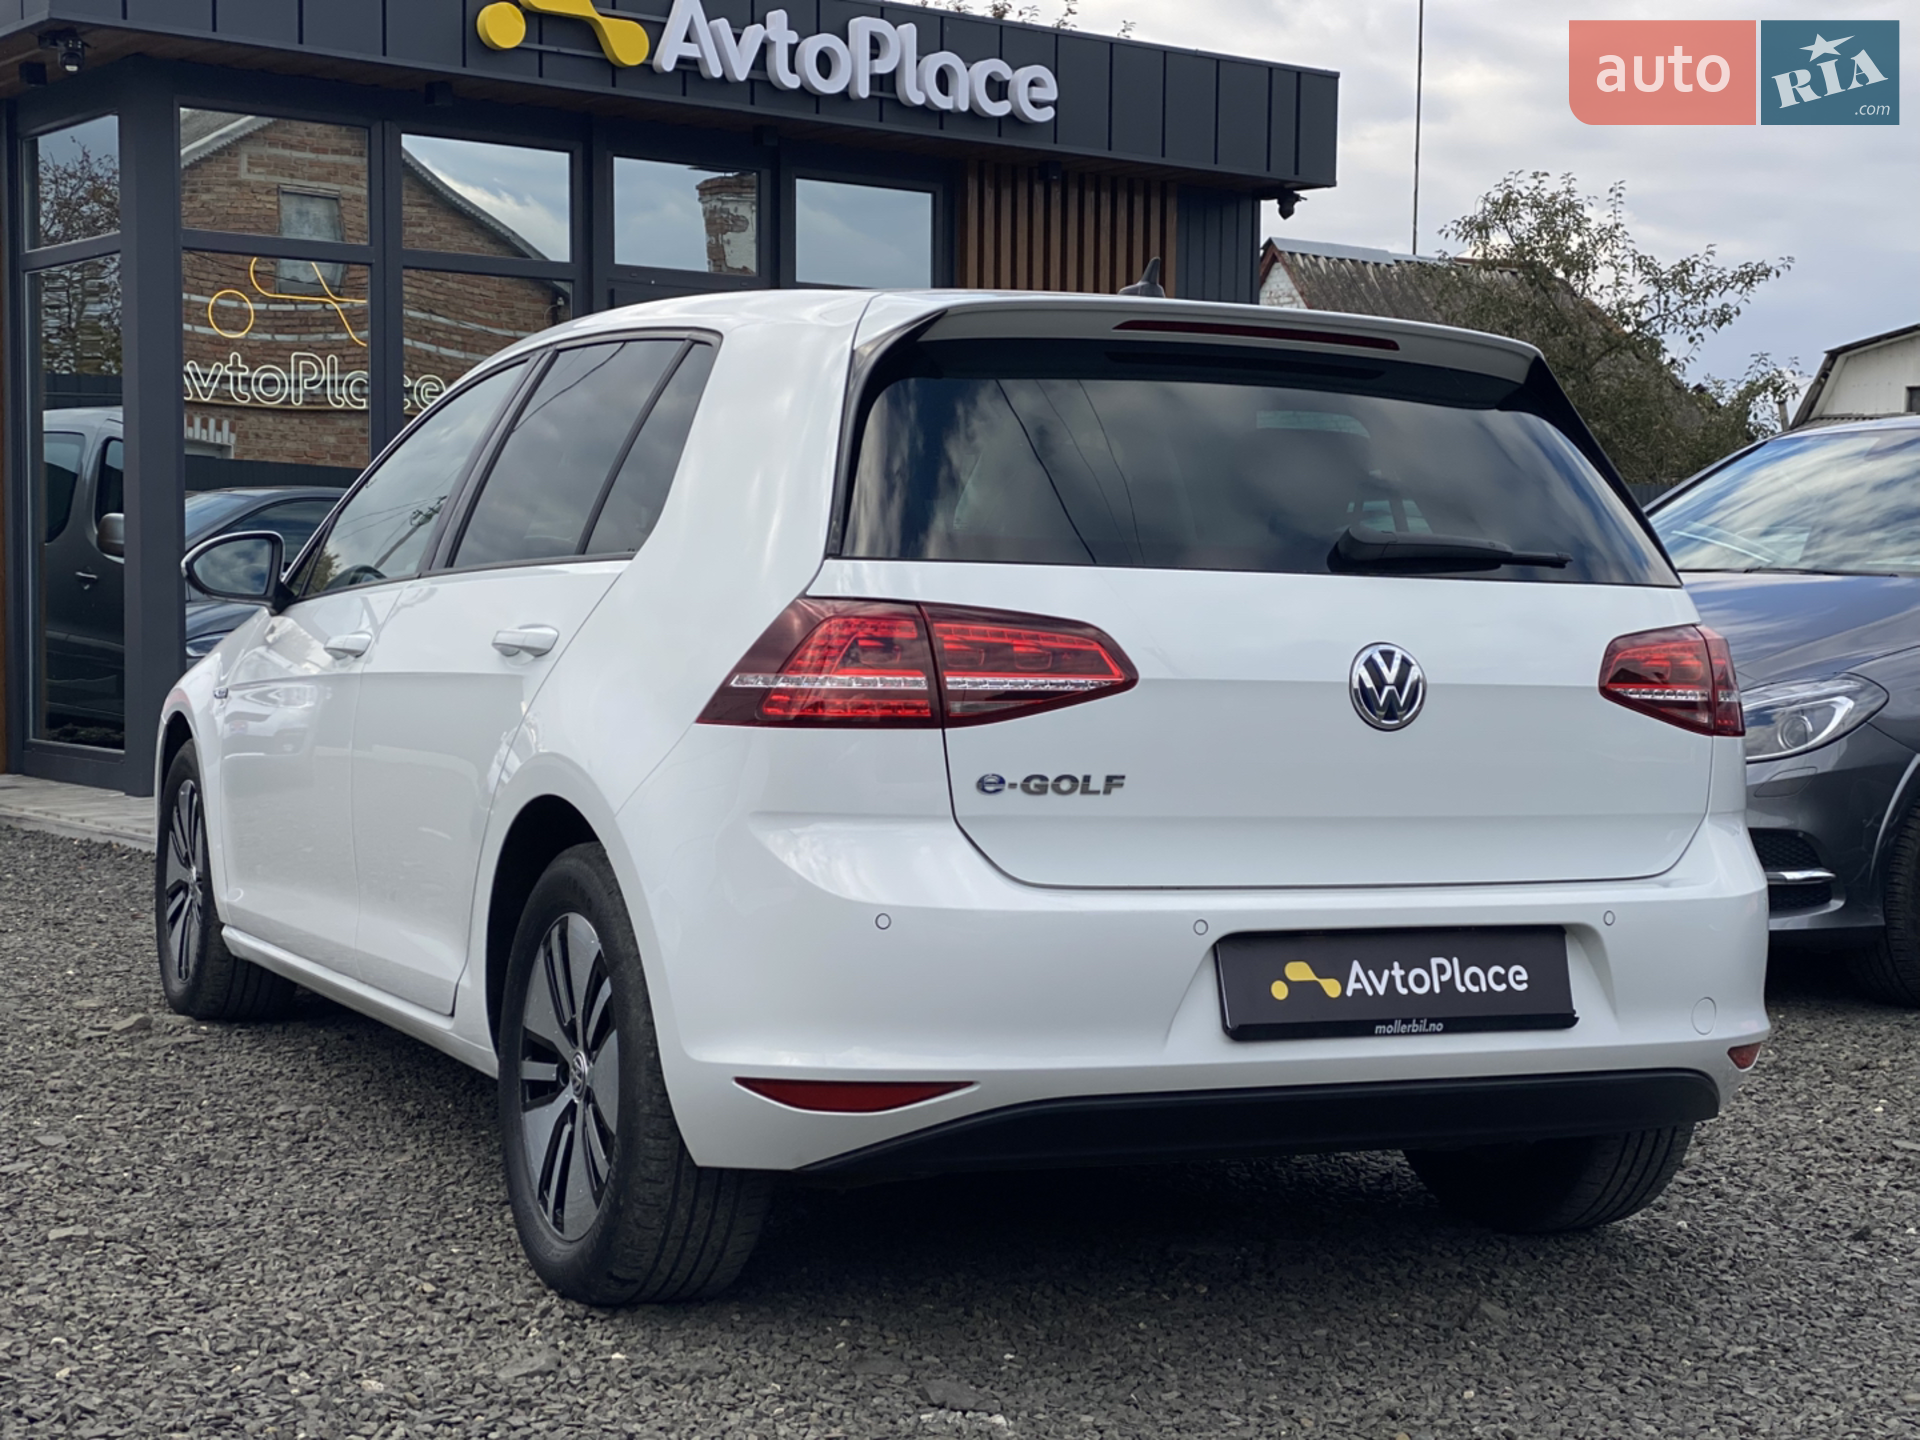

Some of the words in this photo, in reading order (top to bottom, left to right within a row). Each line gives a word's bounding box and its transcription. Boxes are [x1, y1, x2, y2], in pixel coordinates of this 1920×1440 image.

[653, 0, 1059, 123] AvtoPlace
[183, 351, 447, 411] vtoPlae
[976, 773, 1126, 796] e-GOLF
[1346, 957, 1529, 997] AvtoPlace
[1374, 1018, 1444, 1035] mollerbil.no
